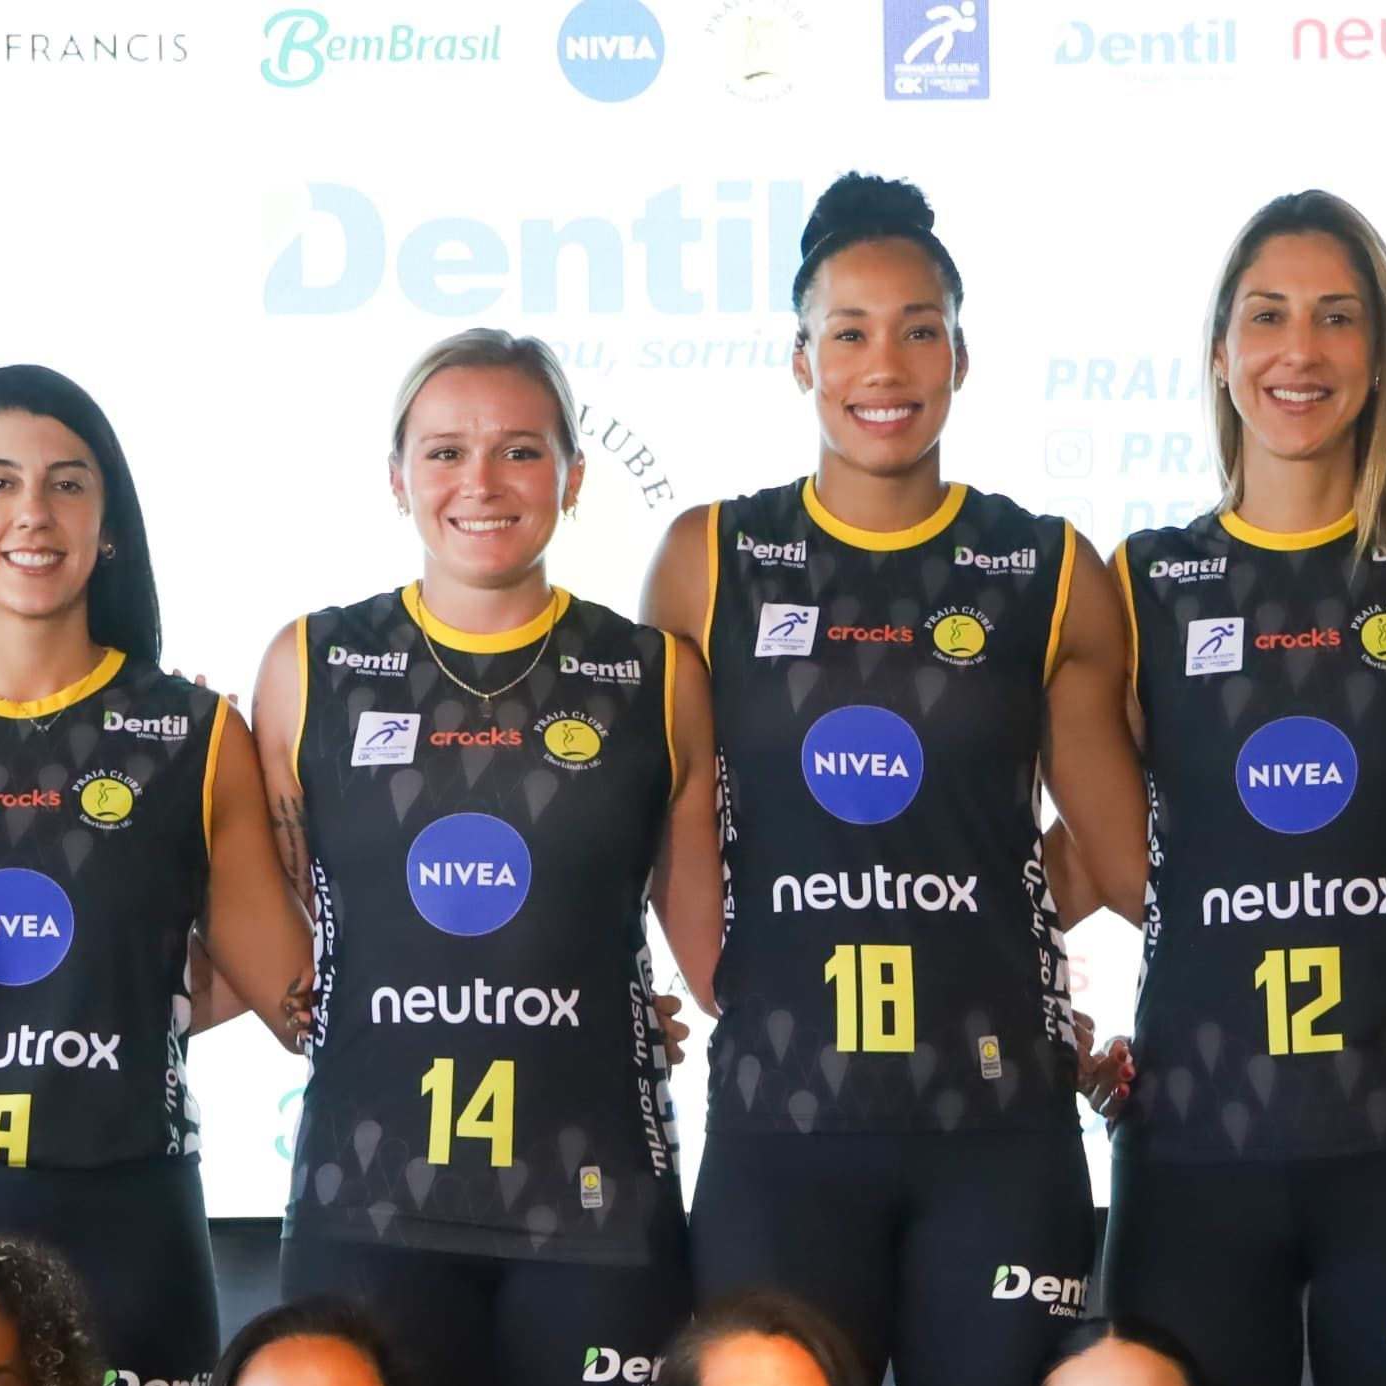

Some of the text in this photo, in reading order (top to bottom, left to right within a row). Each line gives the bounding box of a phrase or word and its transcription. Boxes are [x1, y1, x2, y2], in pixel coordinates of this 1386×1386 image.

[4, 33, 189, 63] FRANCIS
[260, 8, 502, 89] BemBrasil
[566, 35, 656, 60] NIVEA
[1054, 20, 1237, 66] Dentil
[263, 180, 805, 317] Dentil
[575, 403, 675, 508] LUBE
[737, 531, 807, 562] Dentil
[955, 546, 1036, 571] Dentil
[1149, 556, 1228, 580] Dentil
[924, 605, 996, 634] PRAIA CLUBE
[1351, 604, 1382, 632] PRAIA
[327, 645, 409, 672] Dentil
[559, 655, 642, 680] Dentil
[103, 711, 188, 735] Dentil
[533, 709, 611, 739] PRAIA CLUBE
[815, 751, 910, 778] NIVEA
[1248, 761, 1344, 788] NIVEA
[72, 769, 143, 797] PRAIA CLUBE
[419, 862, 517, 887] NIVEA
[772, 864, 978, 913] neutrox
[371, 977, 581, 1027] neutrox
[824, 944, 916, 1053] 18
[1254, 946, 1345, 1056] 12
[420, 1056, 515, 1168] 14
